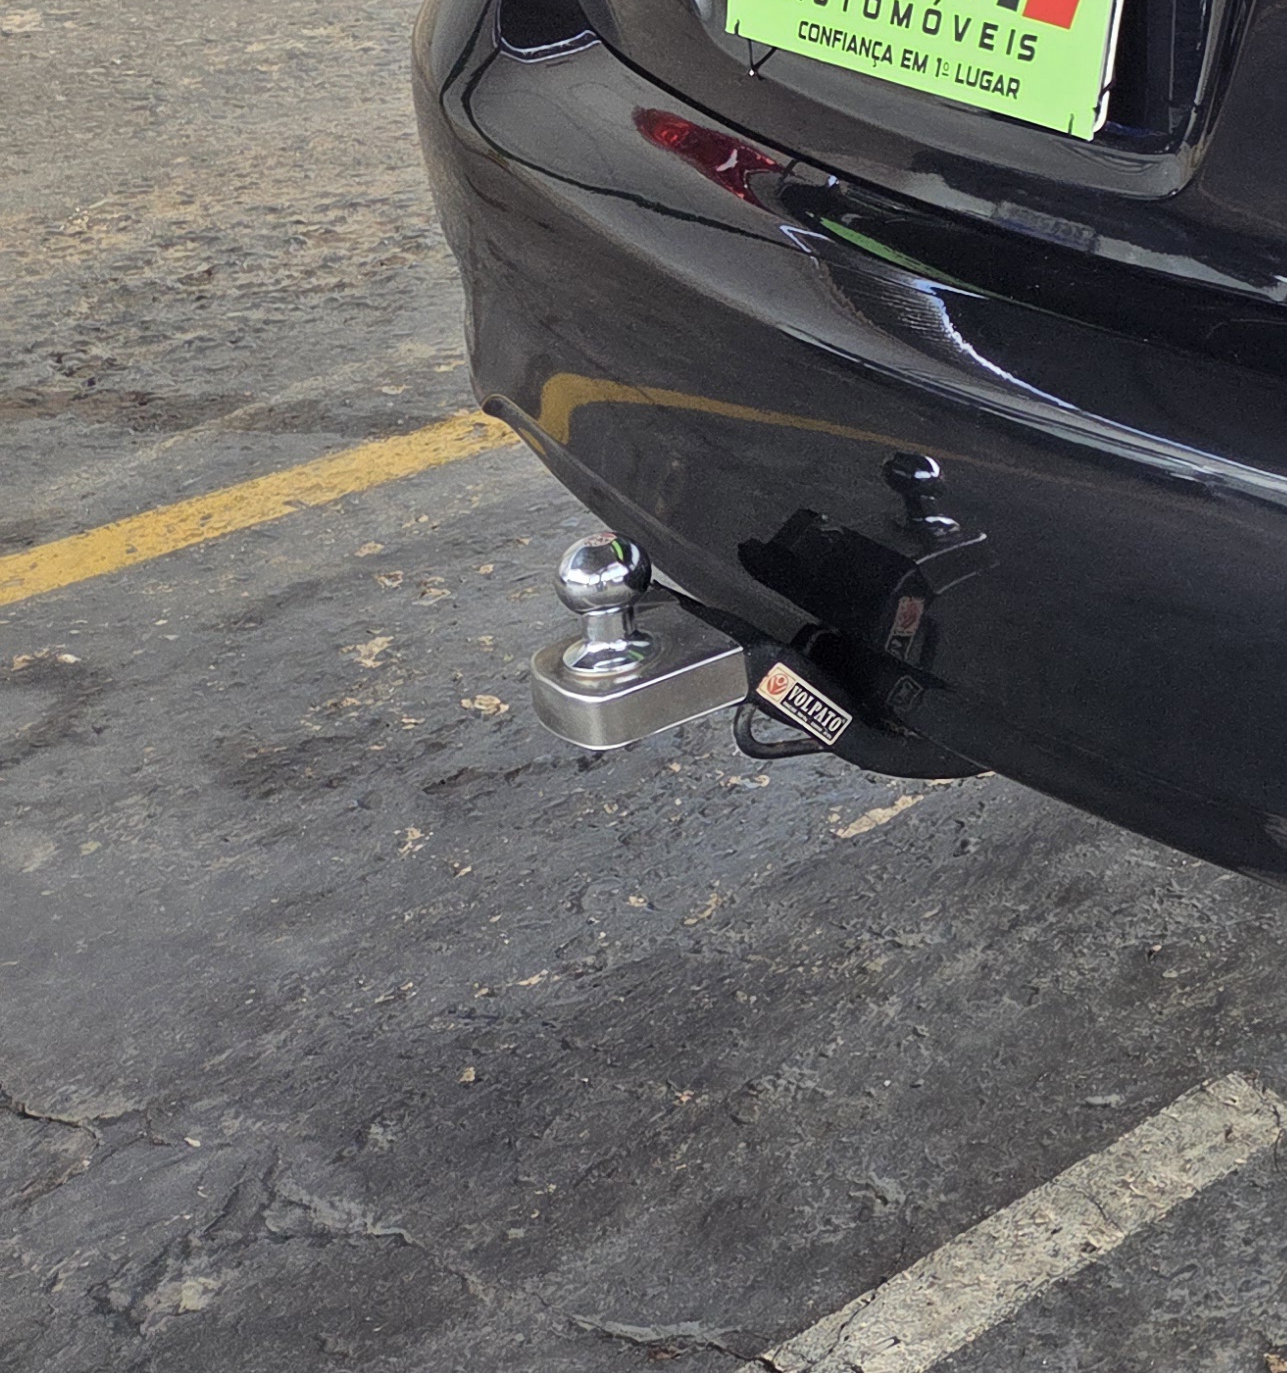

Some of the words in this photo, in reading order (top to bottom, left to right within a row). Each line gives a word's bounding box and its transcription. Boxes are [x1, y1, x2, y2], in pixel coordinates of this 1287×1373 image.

[797, 20, 893, 67] CONFIANÇA
[900, 49, 928, 75] EM
[954, 67, 1021, 100] LUGAR
[787, 685, 842, 732] VOLPATO
